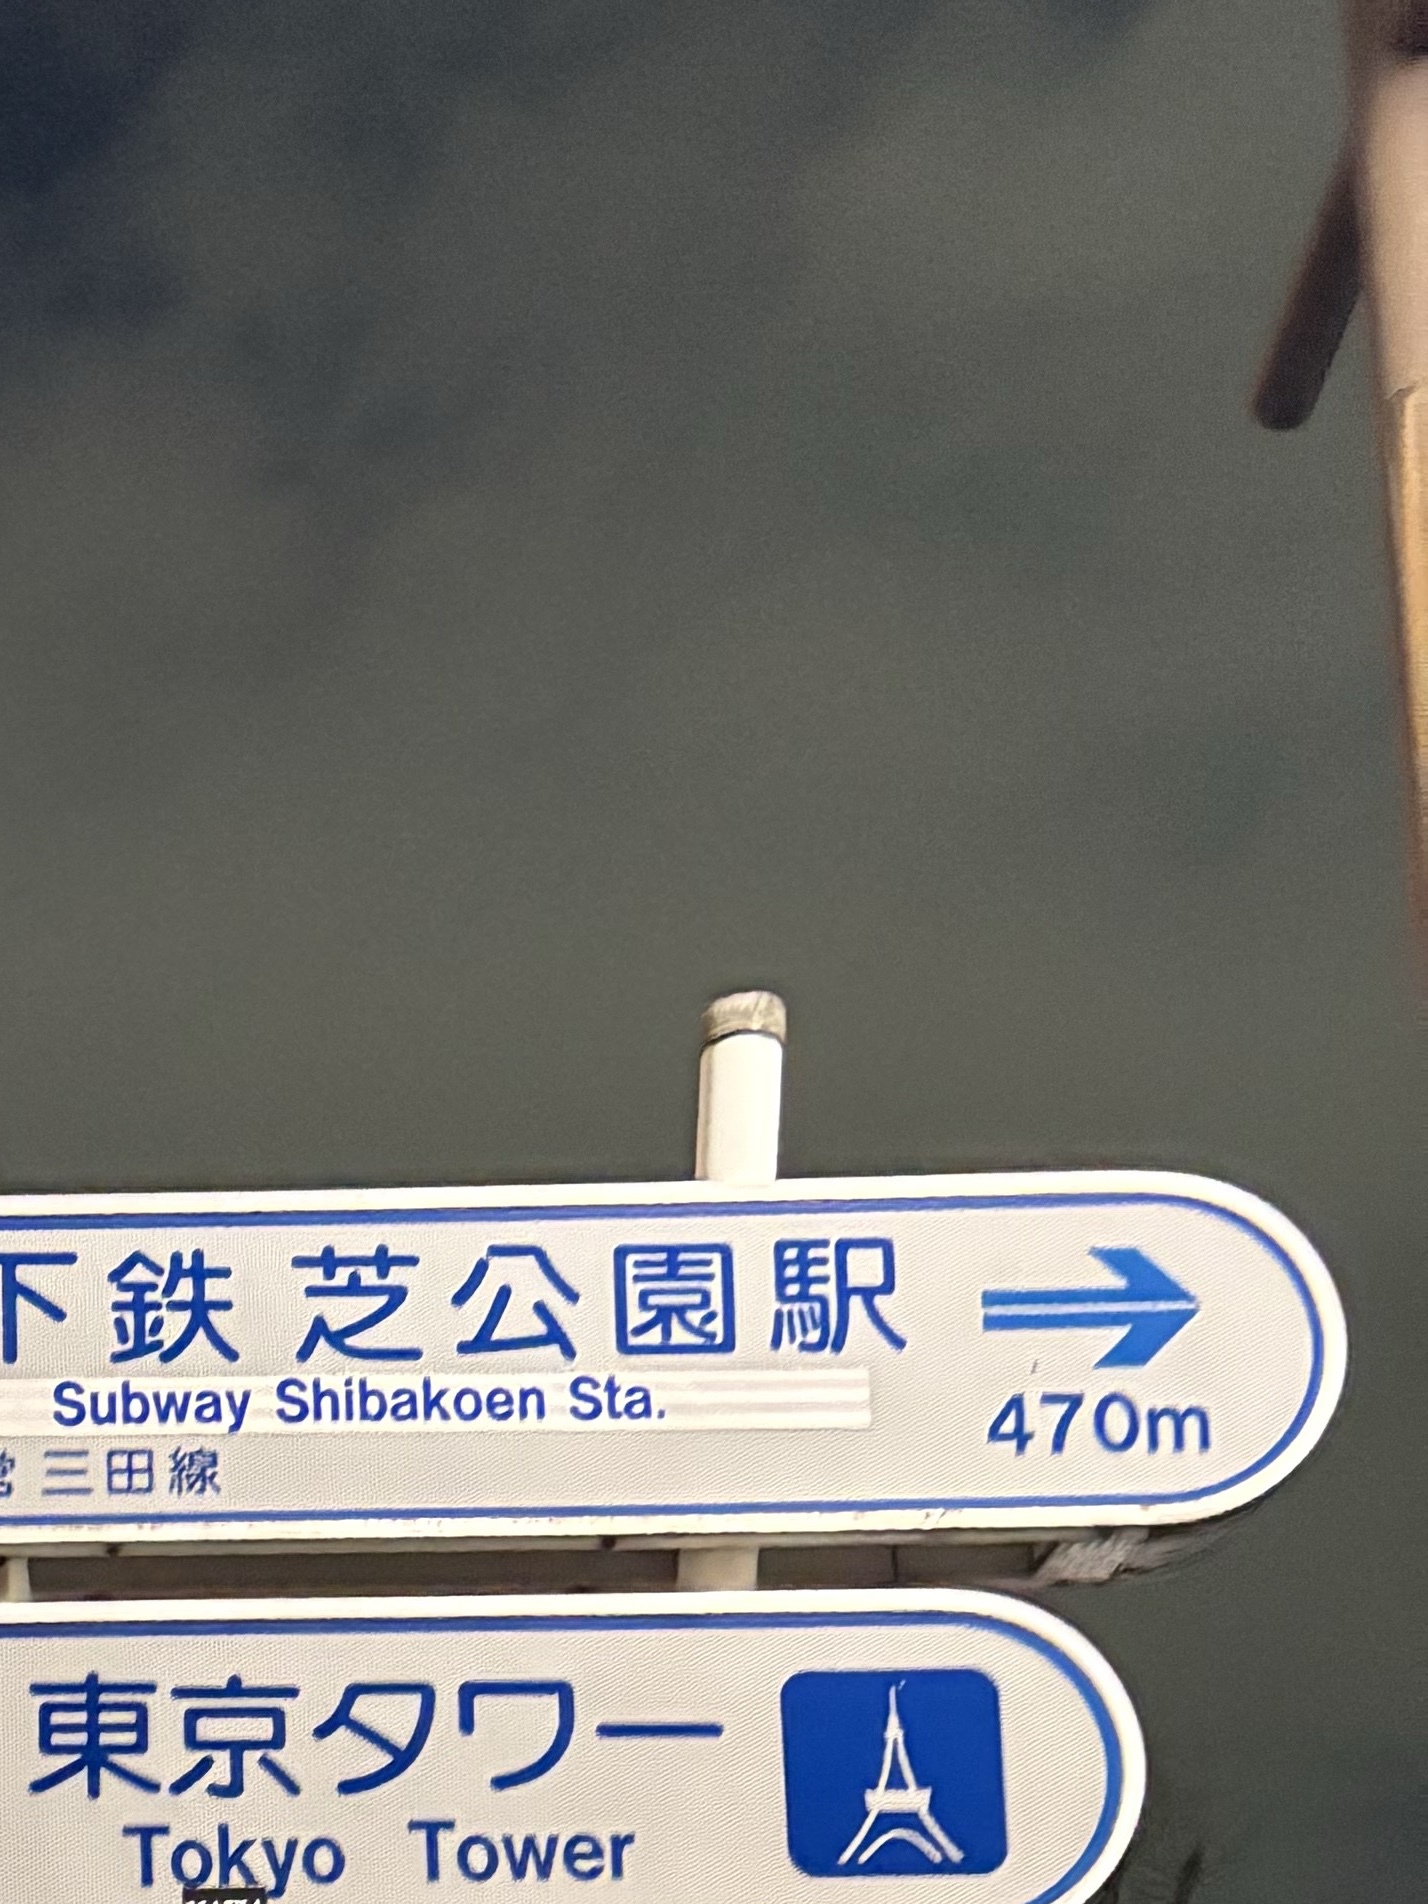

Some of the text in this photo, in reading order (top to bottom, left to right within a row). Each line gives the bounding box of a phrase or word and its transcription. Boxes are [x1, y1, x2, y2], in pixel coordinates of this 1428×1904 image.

[290, 1236, 907, 1363] 芝公園駅
[53, 1375, 665, 1435] Subway Shibakoen Sta.
[987, 1391, 1212, 1456] 470m
[41, 1447, 222, 1497] 三田線
[28, 1673, 724, 1800] 東京タワー
[123, 1819, 634, 1898] Tokyo Tower
